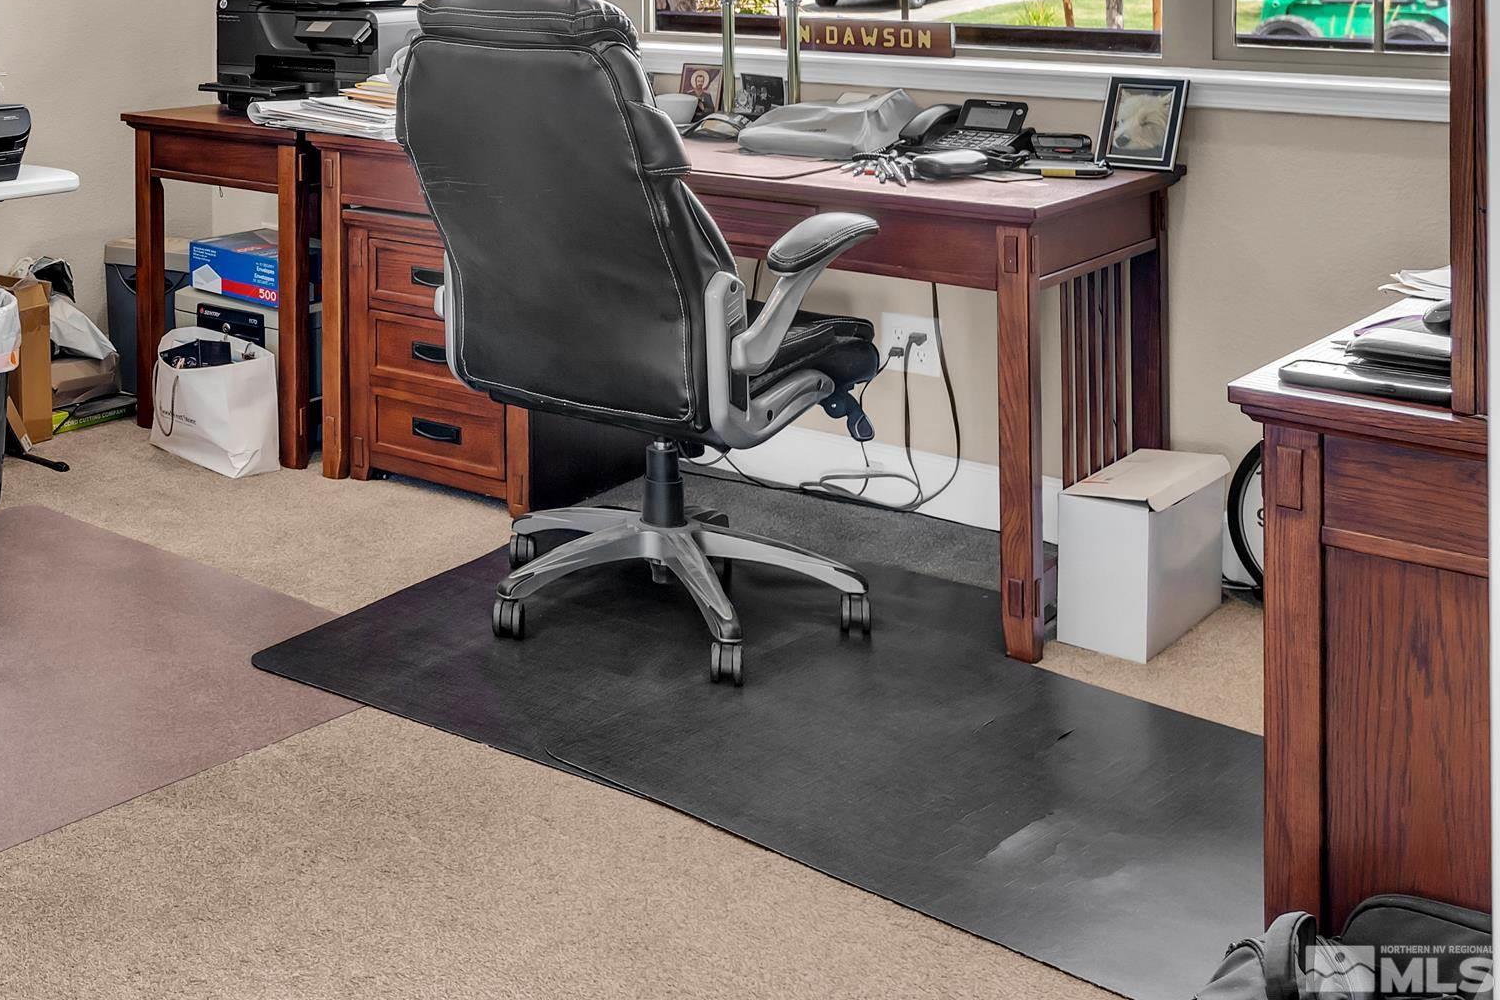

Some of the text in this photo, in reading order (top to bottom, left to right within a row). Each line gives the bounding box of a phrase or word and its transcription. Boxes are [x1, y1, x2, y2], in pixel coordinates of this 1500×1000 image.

[258, 288, 277, 302] 500
[203, 309, 221, 318] SENTRY
[79, 414, 101, 424] CUTTING
[101, 408, 127, 419] COMPANY
